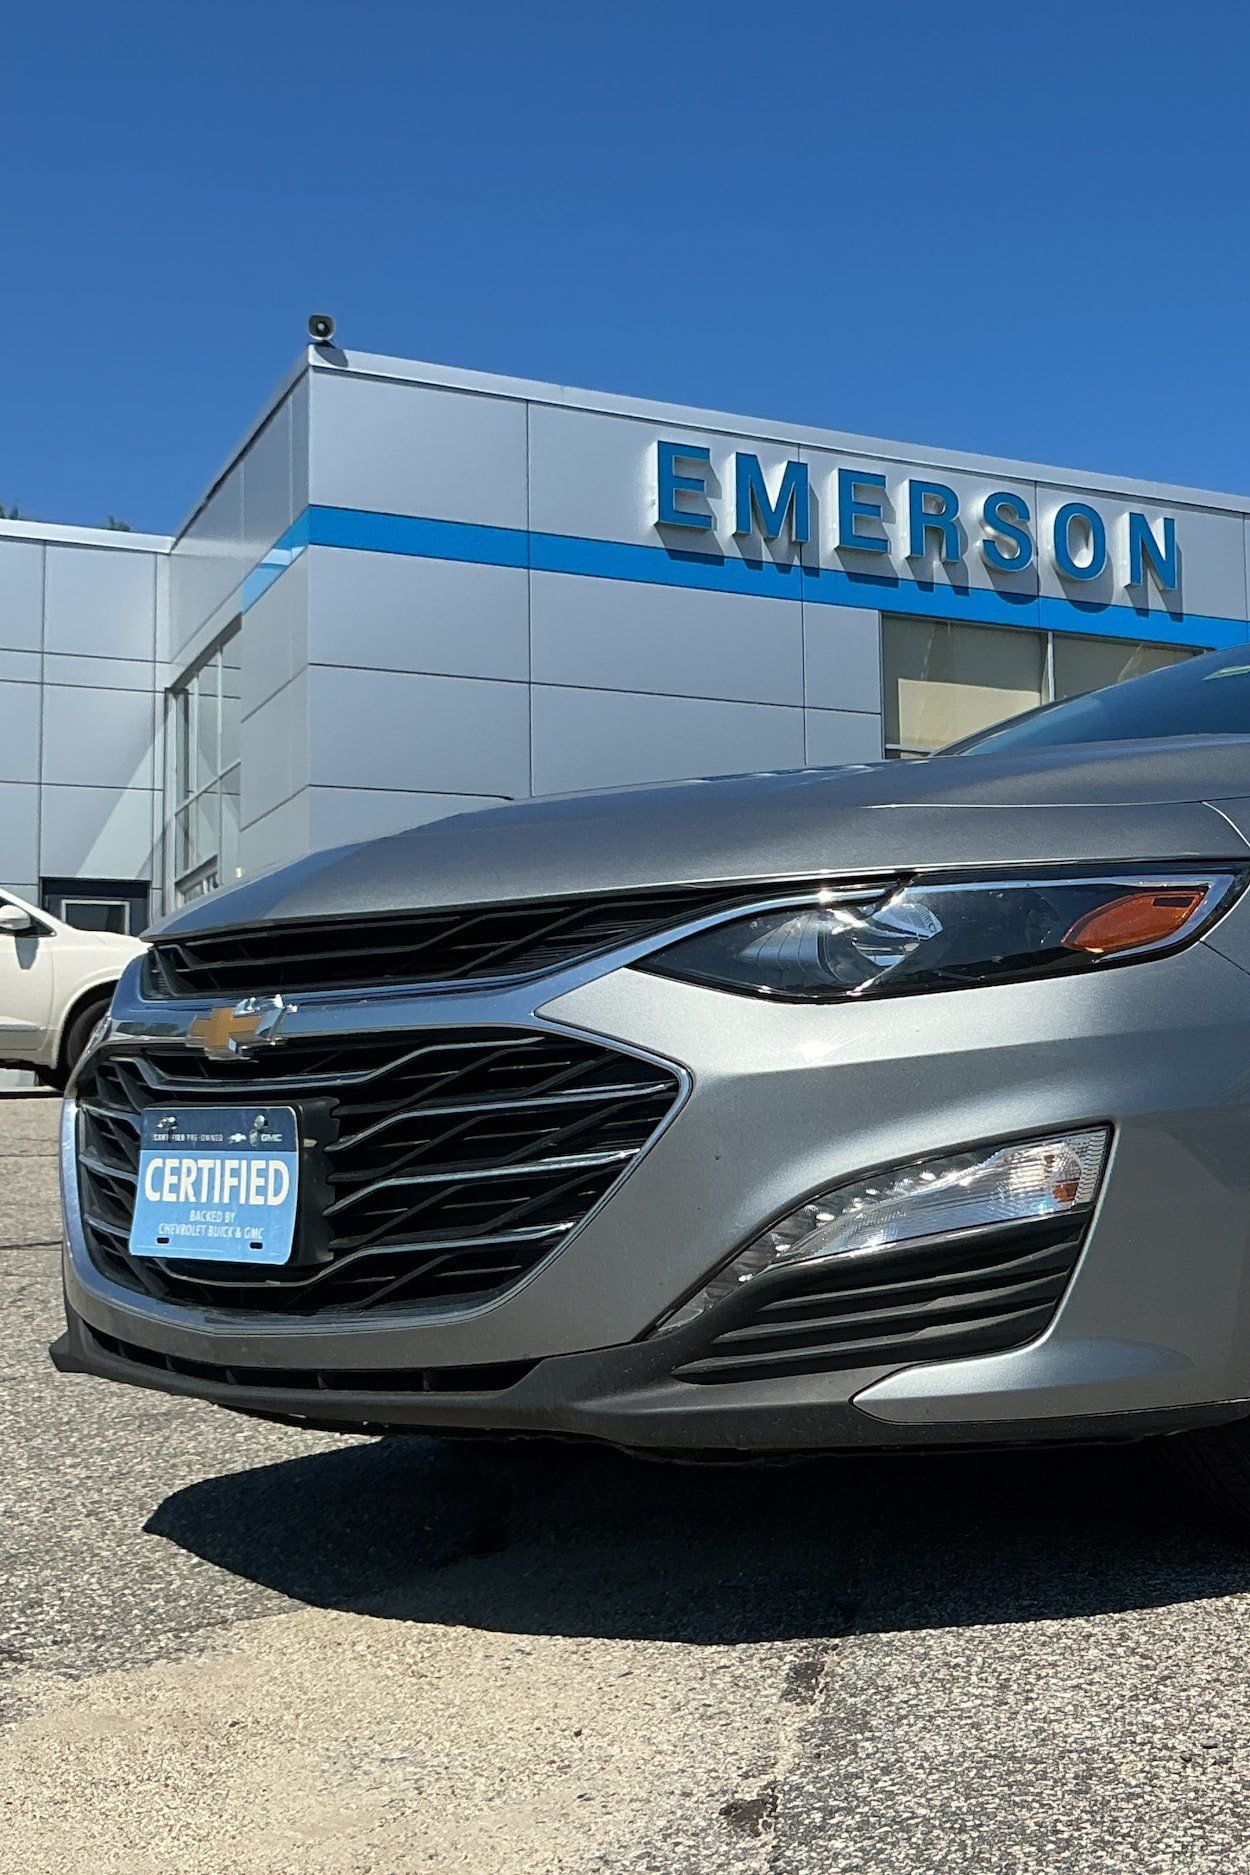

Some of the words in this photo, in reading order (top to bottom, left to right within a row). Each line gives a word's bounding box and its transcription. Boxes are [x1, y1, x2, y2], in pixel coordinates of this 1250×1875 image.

[654, 439, 1178, 591] EMERSON
[260, 1133, 283, 1142] GMC
[145, 1157, 290, 1206] CERTIFIED
[189, 1210, 223, 1222] BACKED
[225, 1211, 237, 1223] BY
[158, 1223, 207, 1237] CHEVROLET
[208, 1225, 234, 1238] BUICK
[235, 1227, 242, 1238] &
[244, 1227, 265, 1239] GMC
